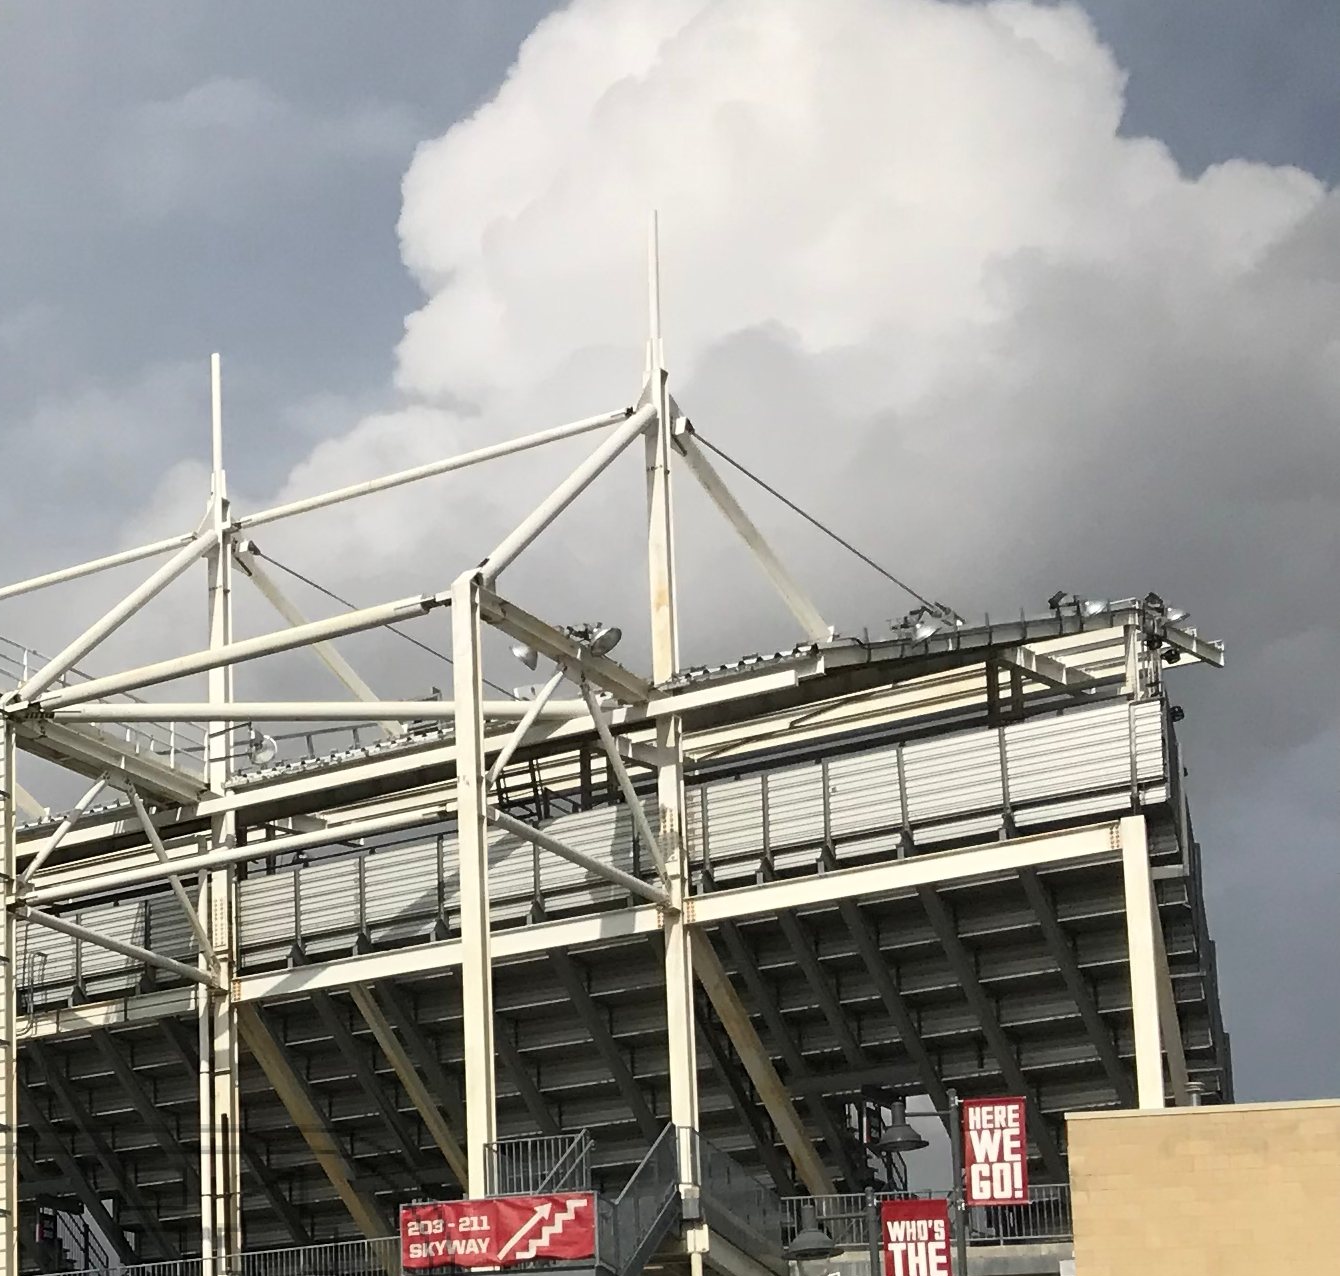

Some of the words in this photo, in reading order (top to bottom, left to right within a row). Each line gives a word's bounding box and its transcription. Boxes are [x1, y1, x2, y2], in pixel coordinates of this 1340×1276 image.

[968, 1104, 1020, 1130] HERE
[970, 1128, 1021, 1162] WE
[970, 1162, 1023, 1199] GO!
[407, 1219, 444, 1236] 203
[458, 1215, 490, 1232] 211
[887, 1220, 945, 1242] WHO'S
[409, 1237, 490, 1259] SKYWAY
